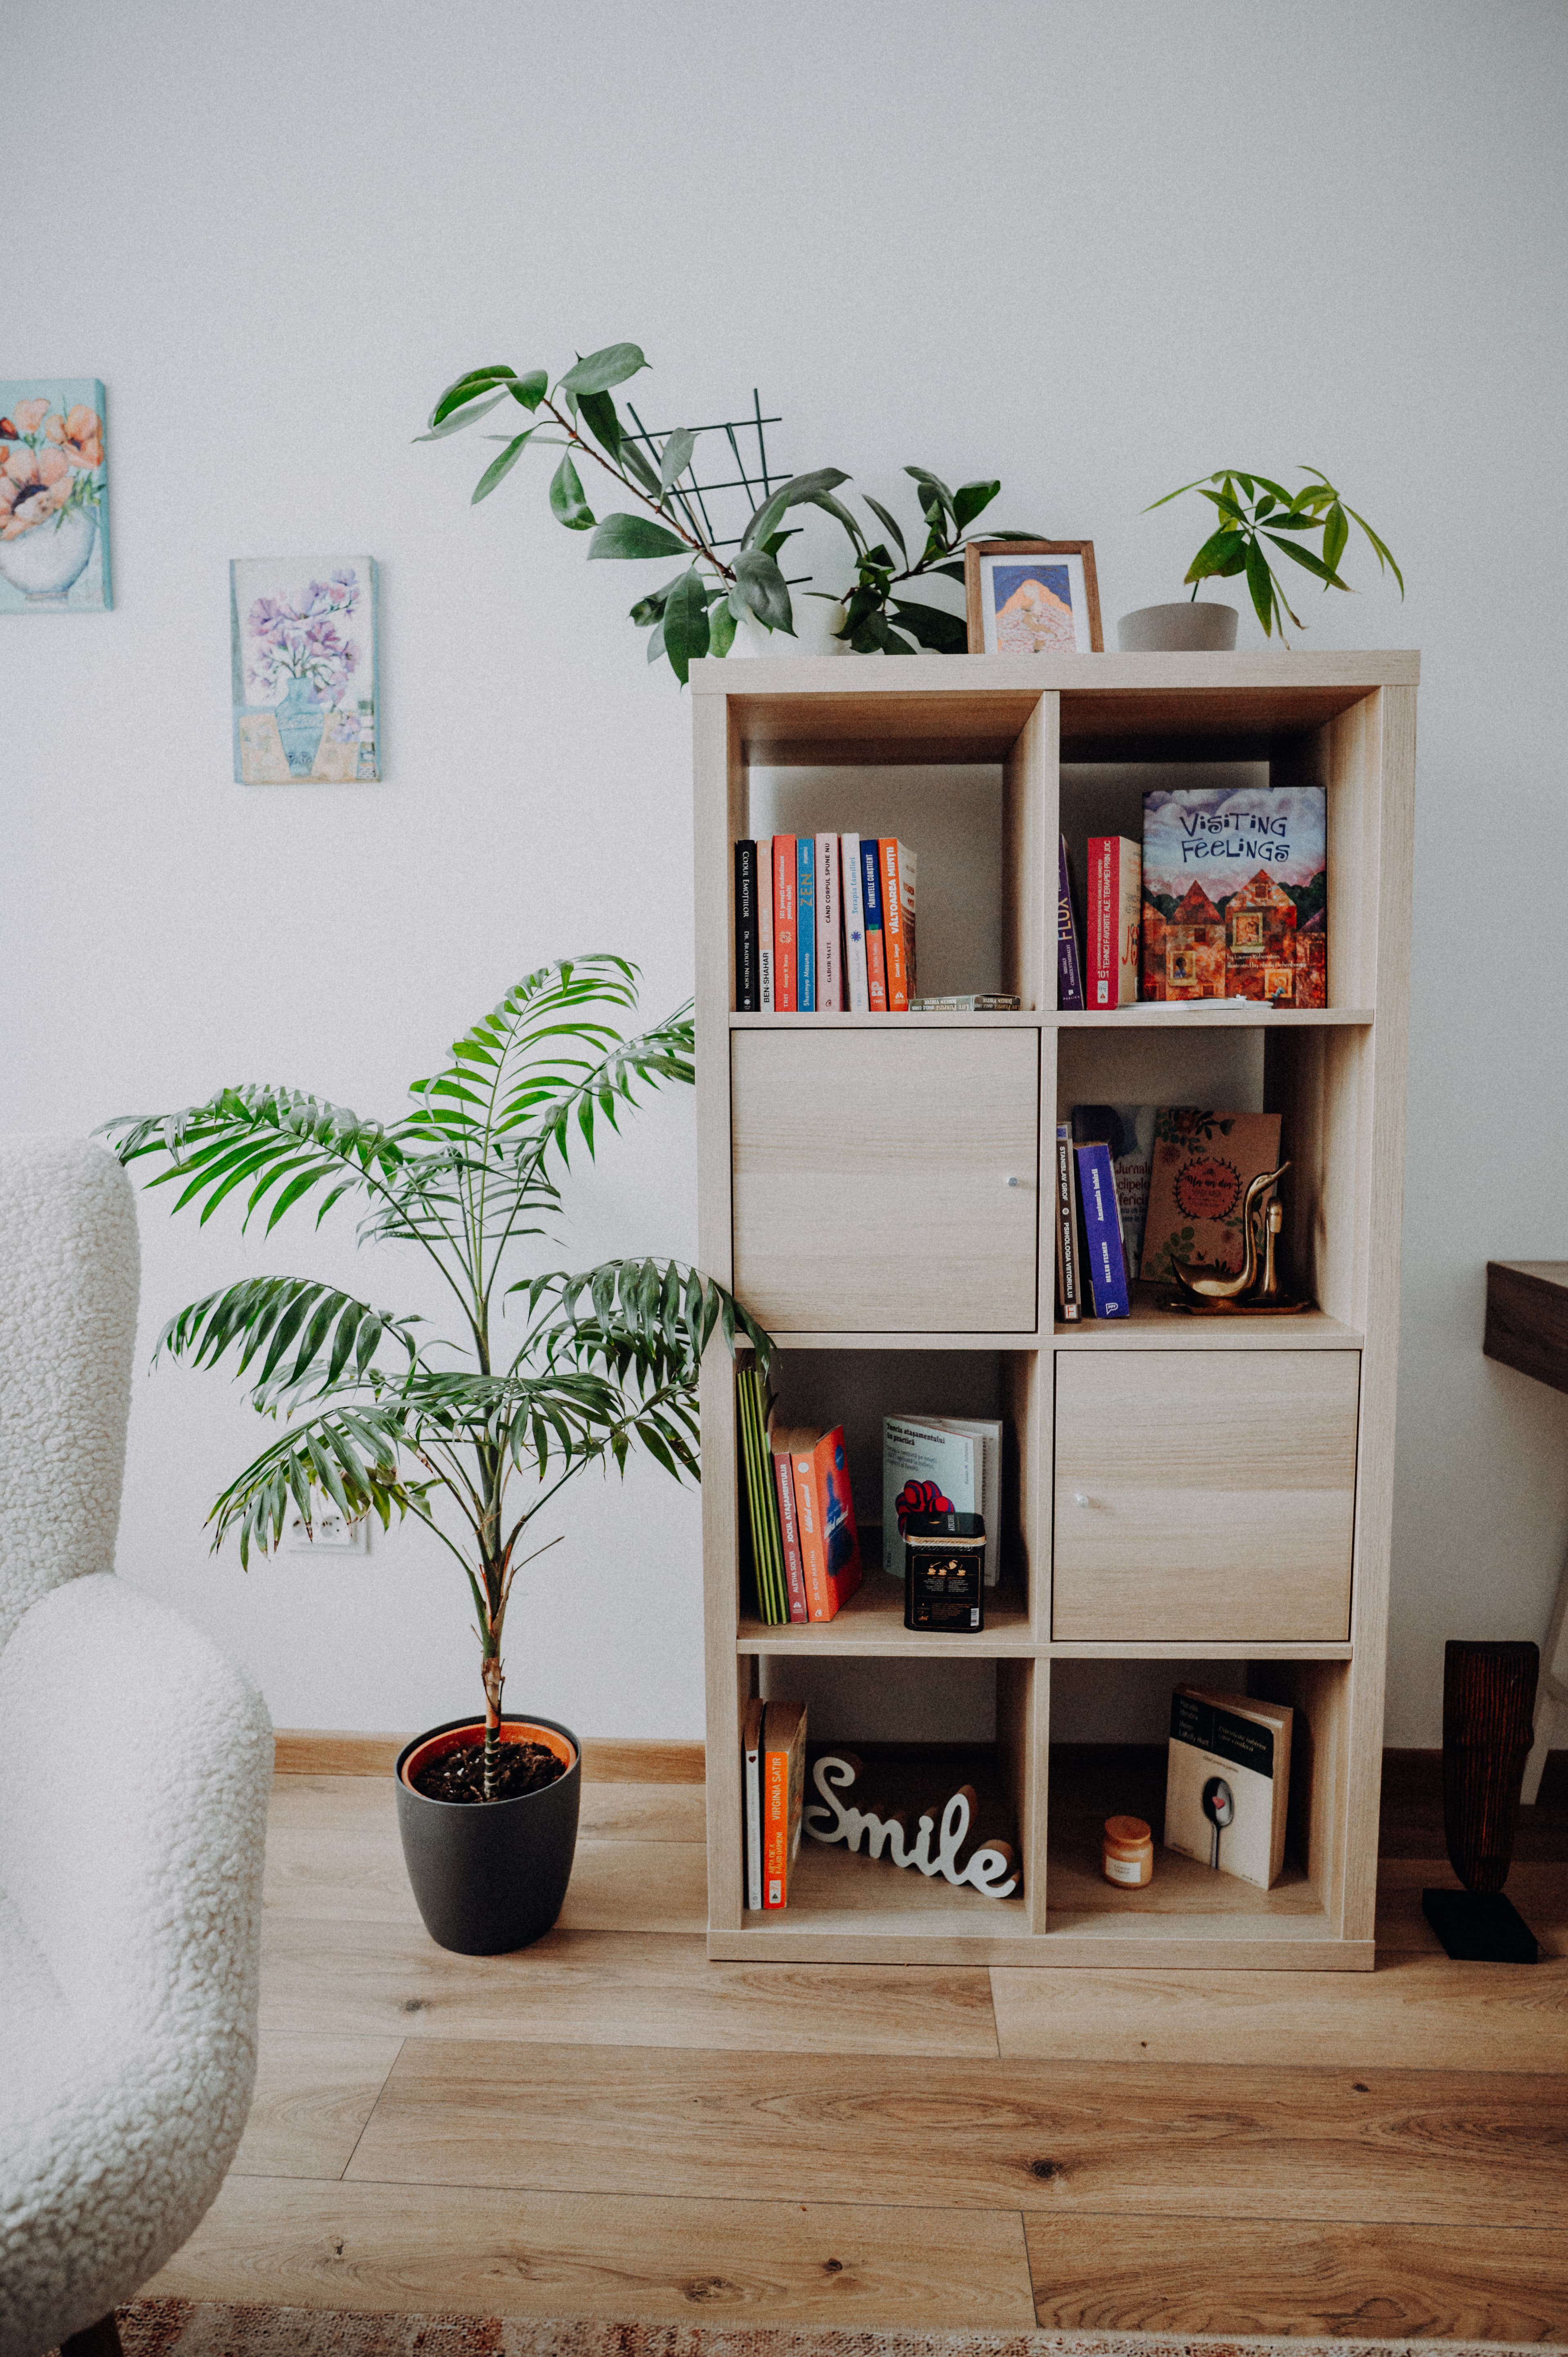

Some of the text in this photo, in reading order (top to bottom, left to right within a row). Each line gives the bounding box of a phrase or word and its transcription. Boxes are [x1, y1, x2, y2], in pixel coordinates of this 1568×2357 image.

[825, 843, 830, 852] NU
[800, 873, 813, 907] ZEN
[889, 879, 900, 934] VÂLTOAREA
[1097, 970, 1109, 979] 101
[1091, 1168, 1105, 1222] Anatomia iubirii
[1101, 1242, 1112, 1283] HELEN FISHER
[886, 1423, 945, 1444] Teoria atașamentului
[893, 1434, 915, 1446] practică
[780, 1464, 795, 1543] JOCUL ATAȘAMENTULUI
[789, 1551, 799, 1593] ALETHA SOLTER
[771, 1757, 781, 1820] VIRGINIA SATIR
[802, 1757, 1016, 1898] Smile
